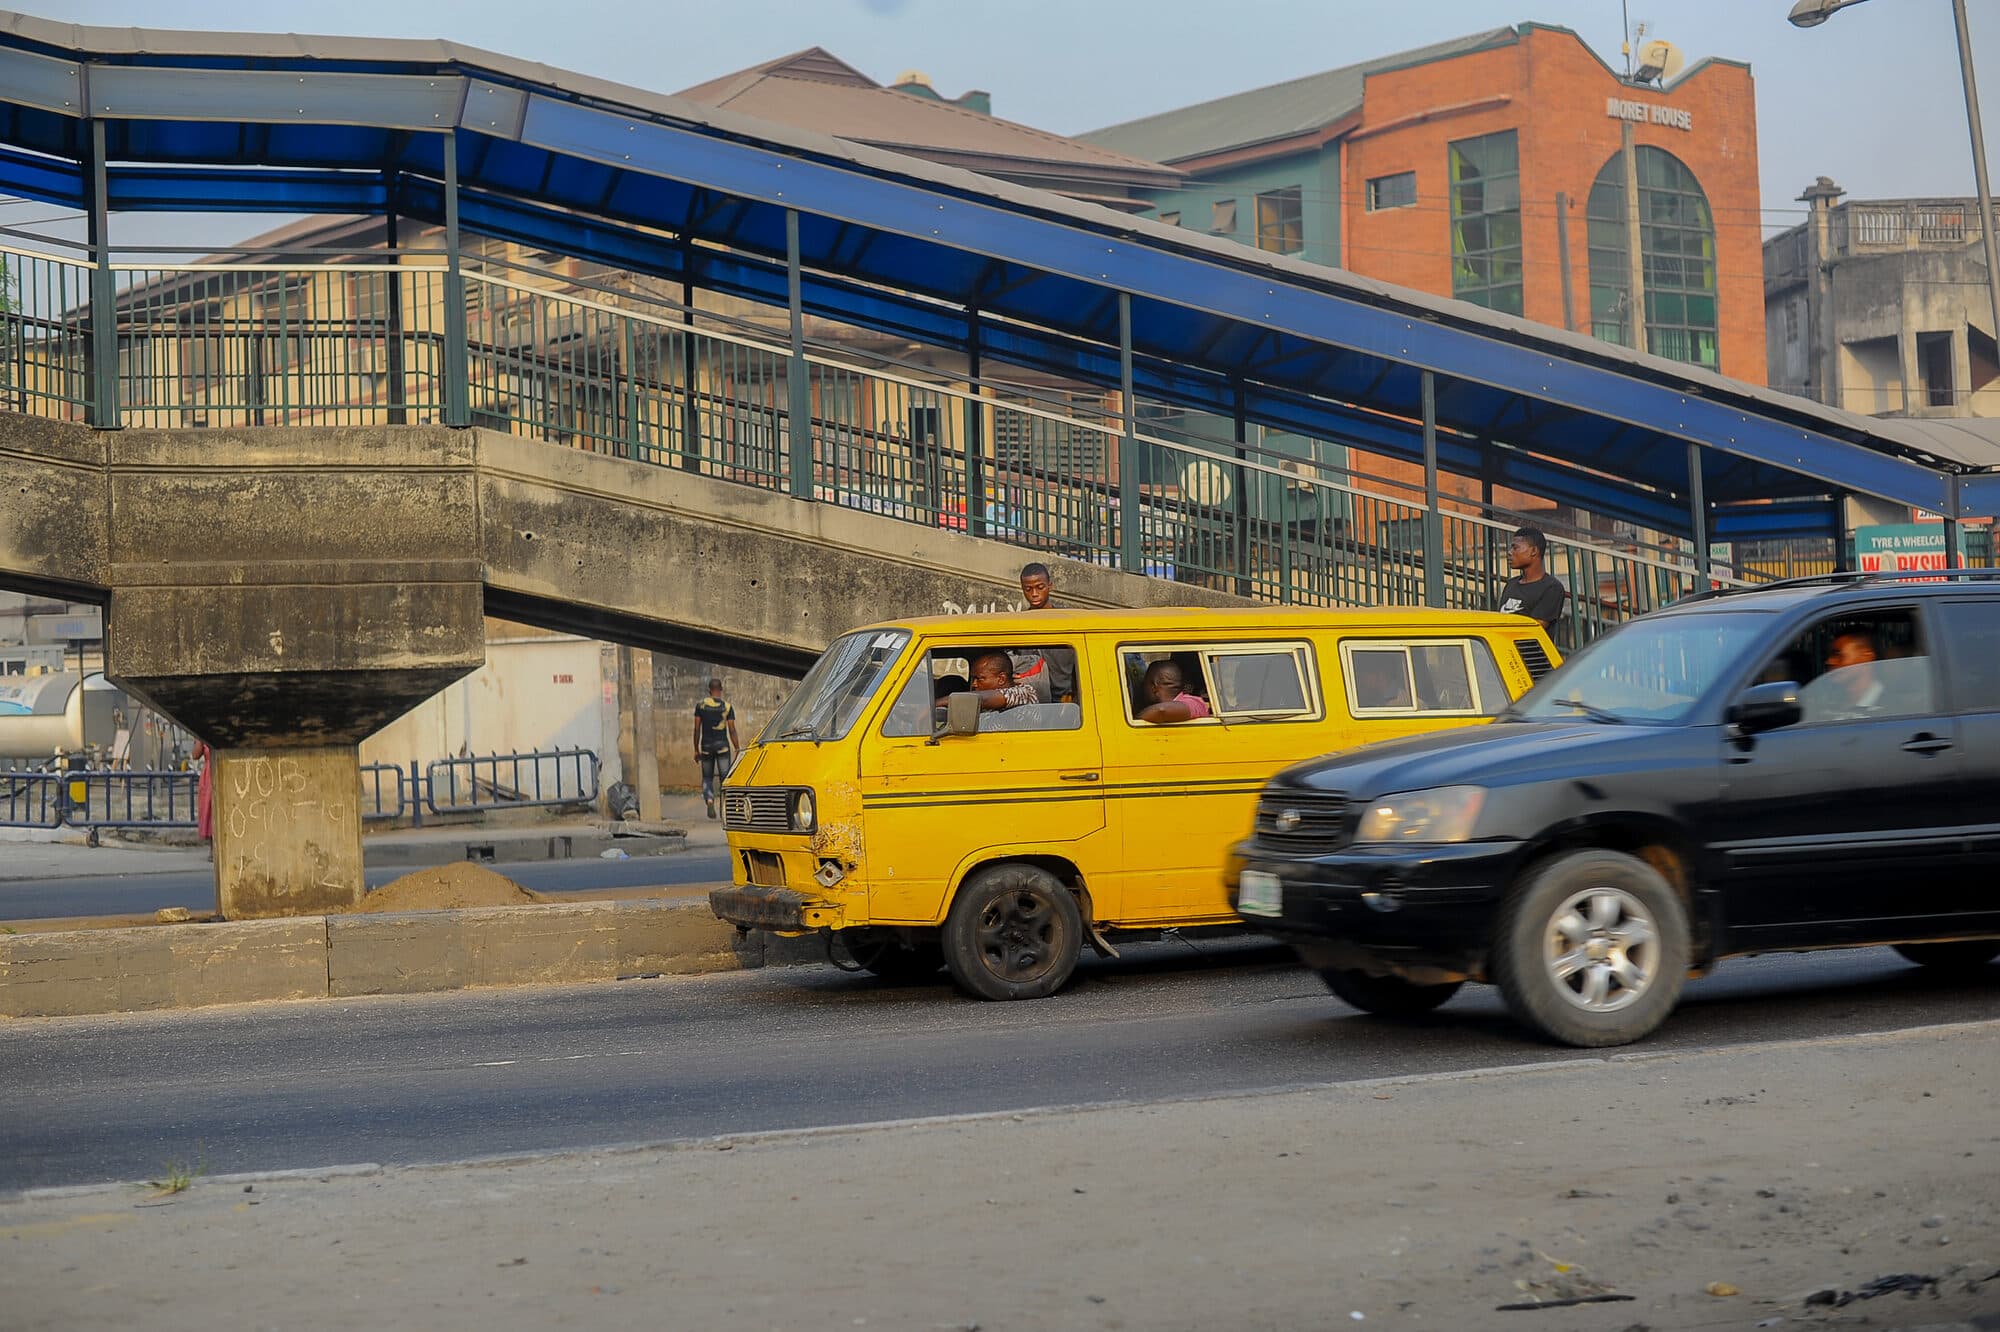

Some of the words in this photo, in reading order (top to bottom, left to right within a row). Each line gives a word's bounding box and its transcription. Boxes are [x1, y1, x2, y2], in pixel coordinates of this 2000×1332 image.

[1651, 104, 1692, 131] HOUSE
[1871, 536, 1893, 549] TYRE
[1894, 536, 1902, 548] &
[228, 757, 306, 799] JOB
